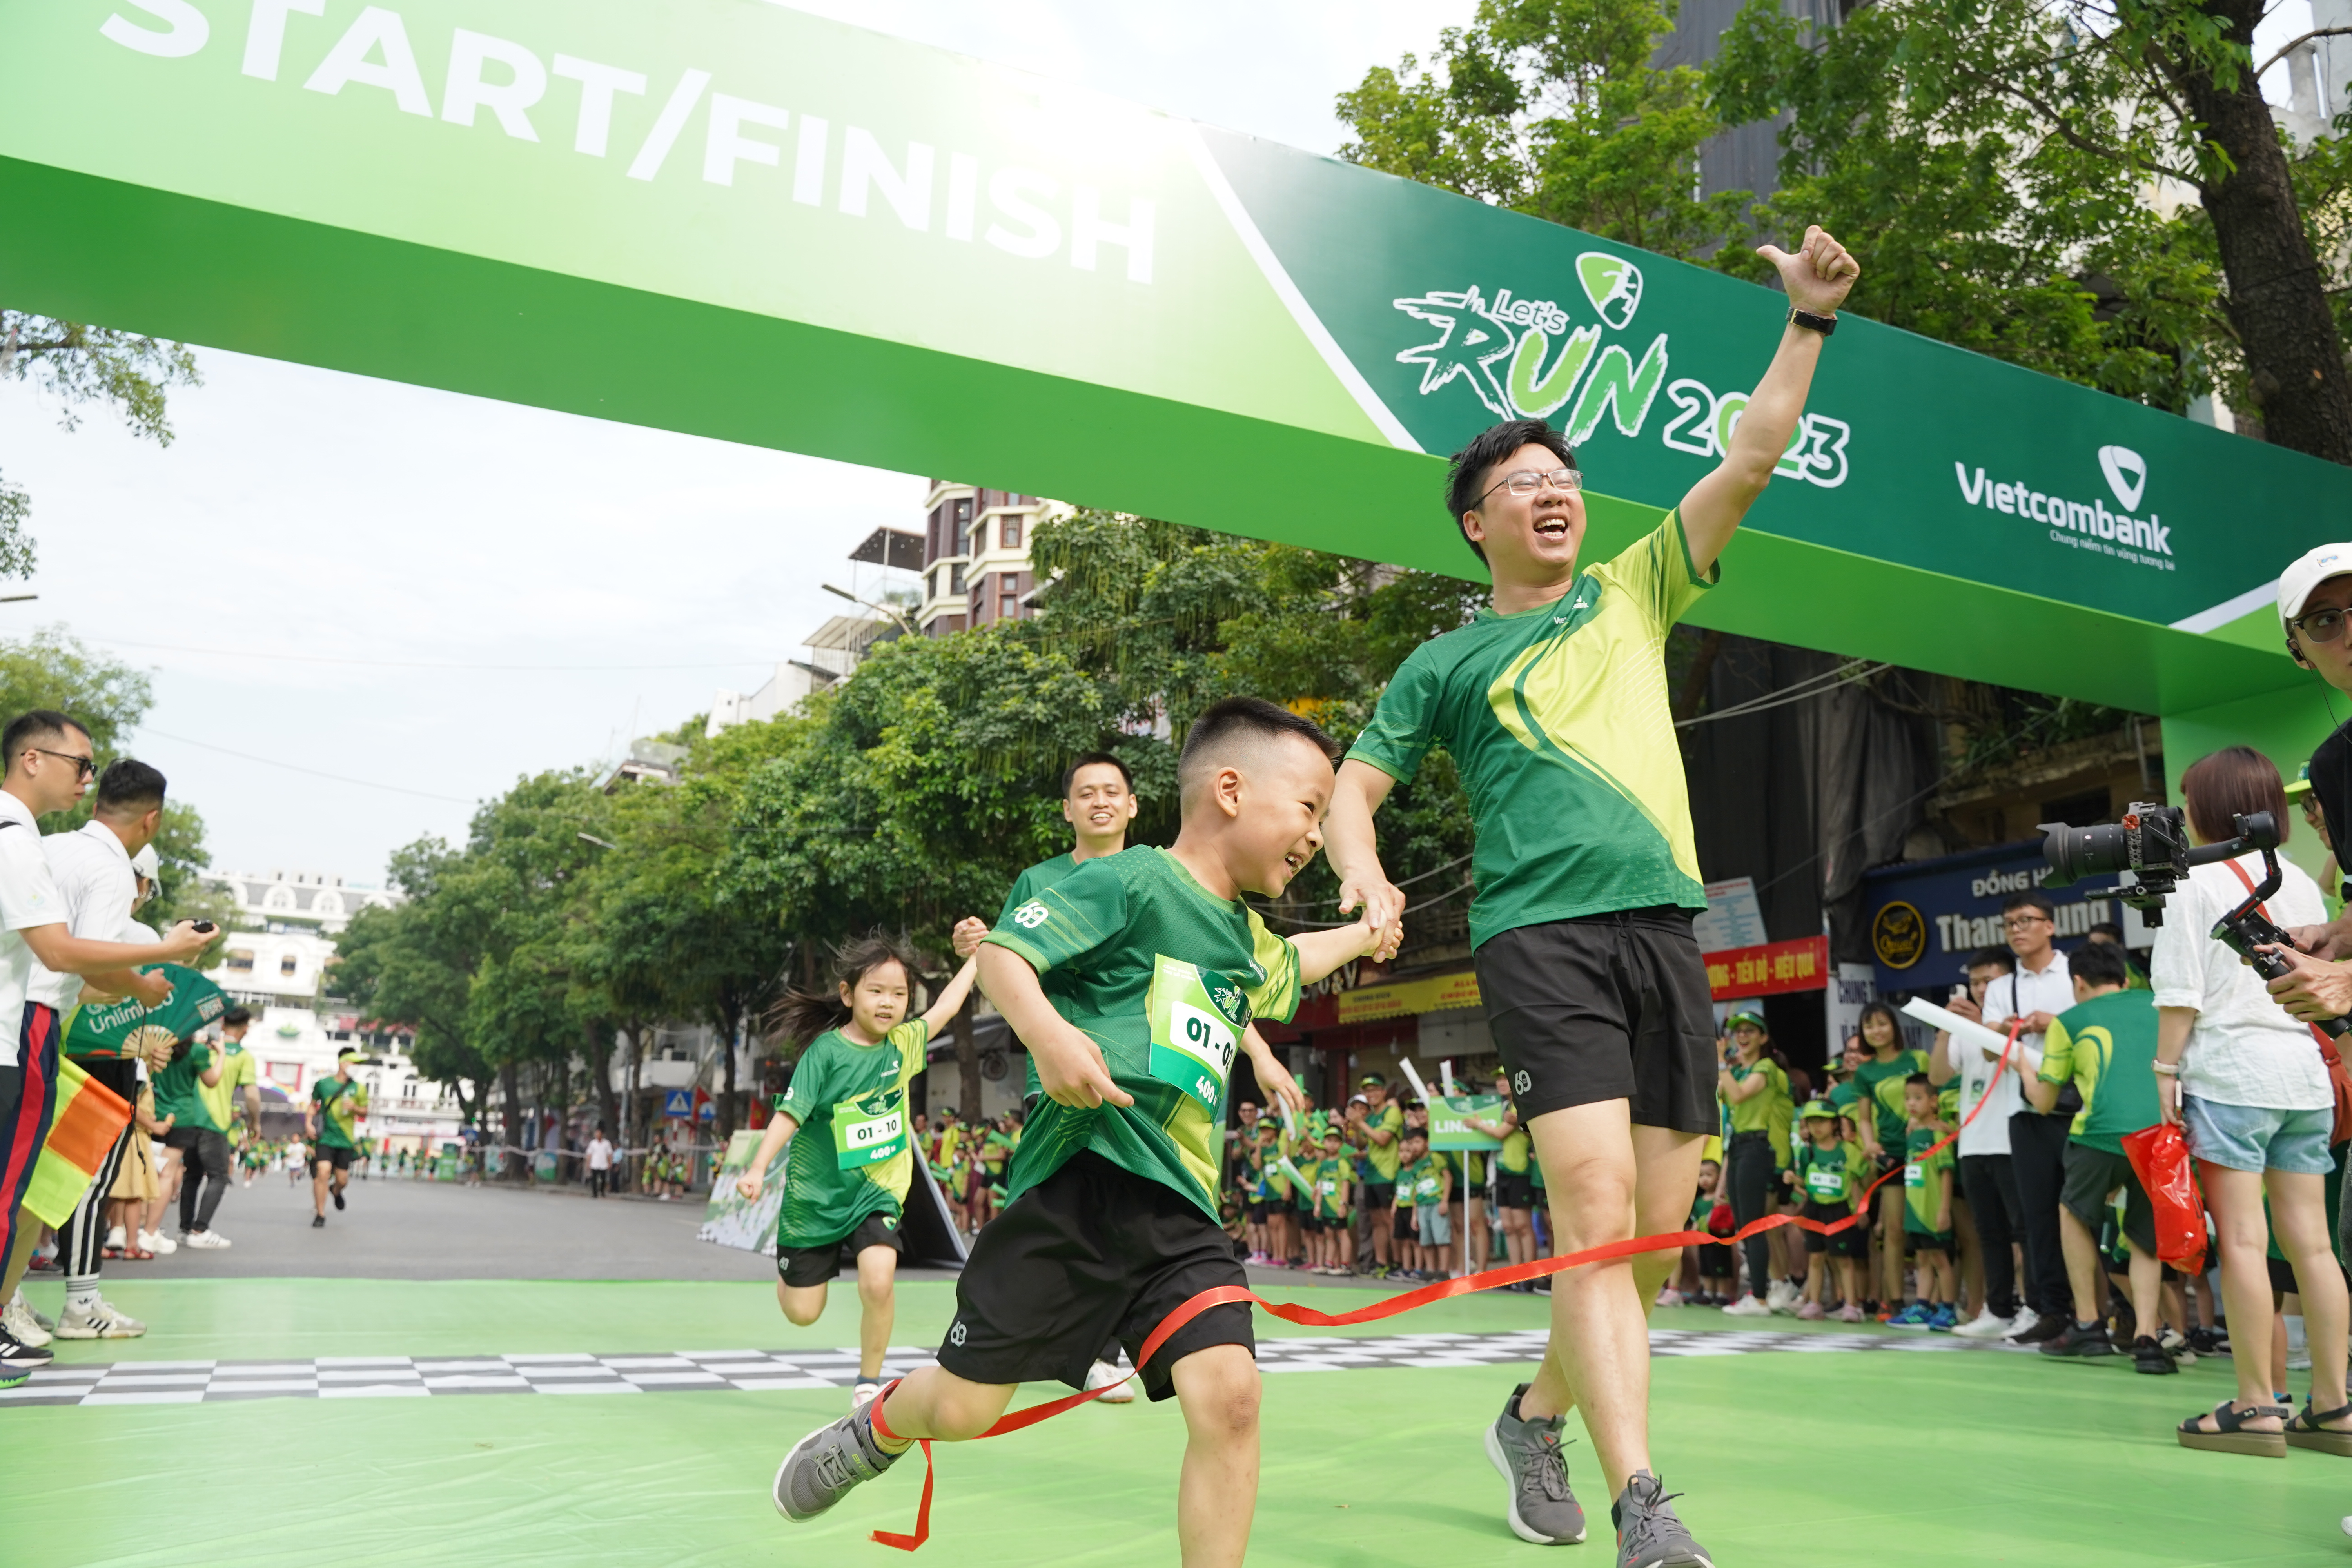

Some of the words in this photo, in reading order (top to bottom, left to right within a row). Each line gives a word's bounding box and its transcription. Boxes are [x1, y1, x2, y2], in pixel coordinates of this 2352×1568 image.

[99, 0, 1156, 285] START/FINISH
[1491, 289, 1570, 336] Let's
[1393, 285, 1668, 448] RUN
[1955, 461, 2173, 555] Vietcombank
[1971, 868, 2030, 897] ĐỒNG
[1936, 913, 2006, 952] Than
[89, 990, 174, 1034] Unlimi
[1186, 1017, 1211, 1049] 01
[1515, 1069, 1532, 1095] 60
[857, 1127, 873, 1140] 01
[886, 1119, 897, 1132] 10
